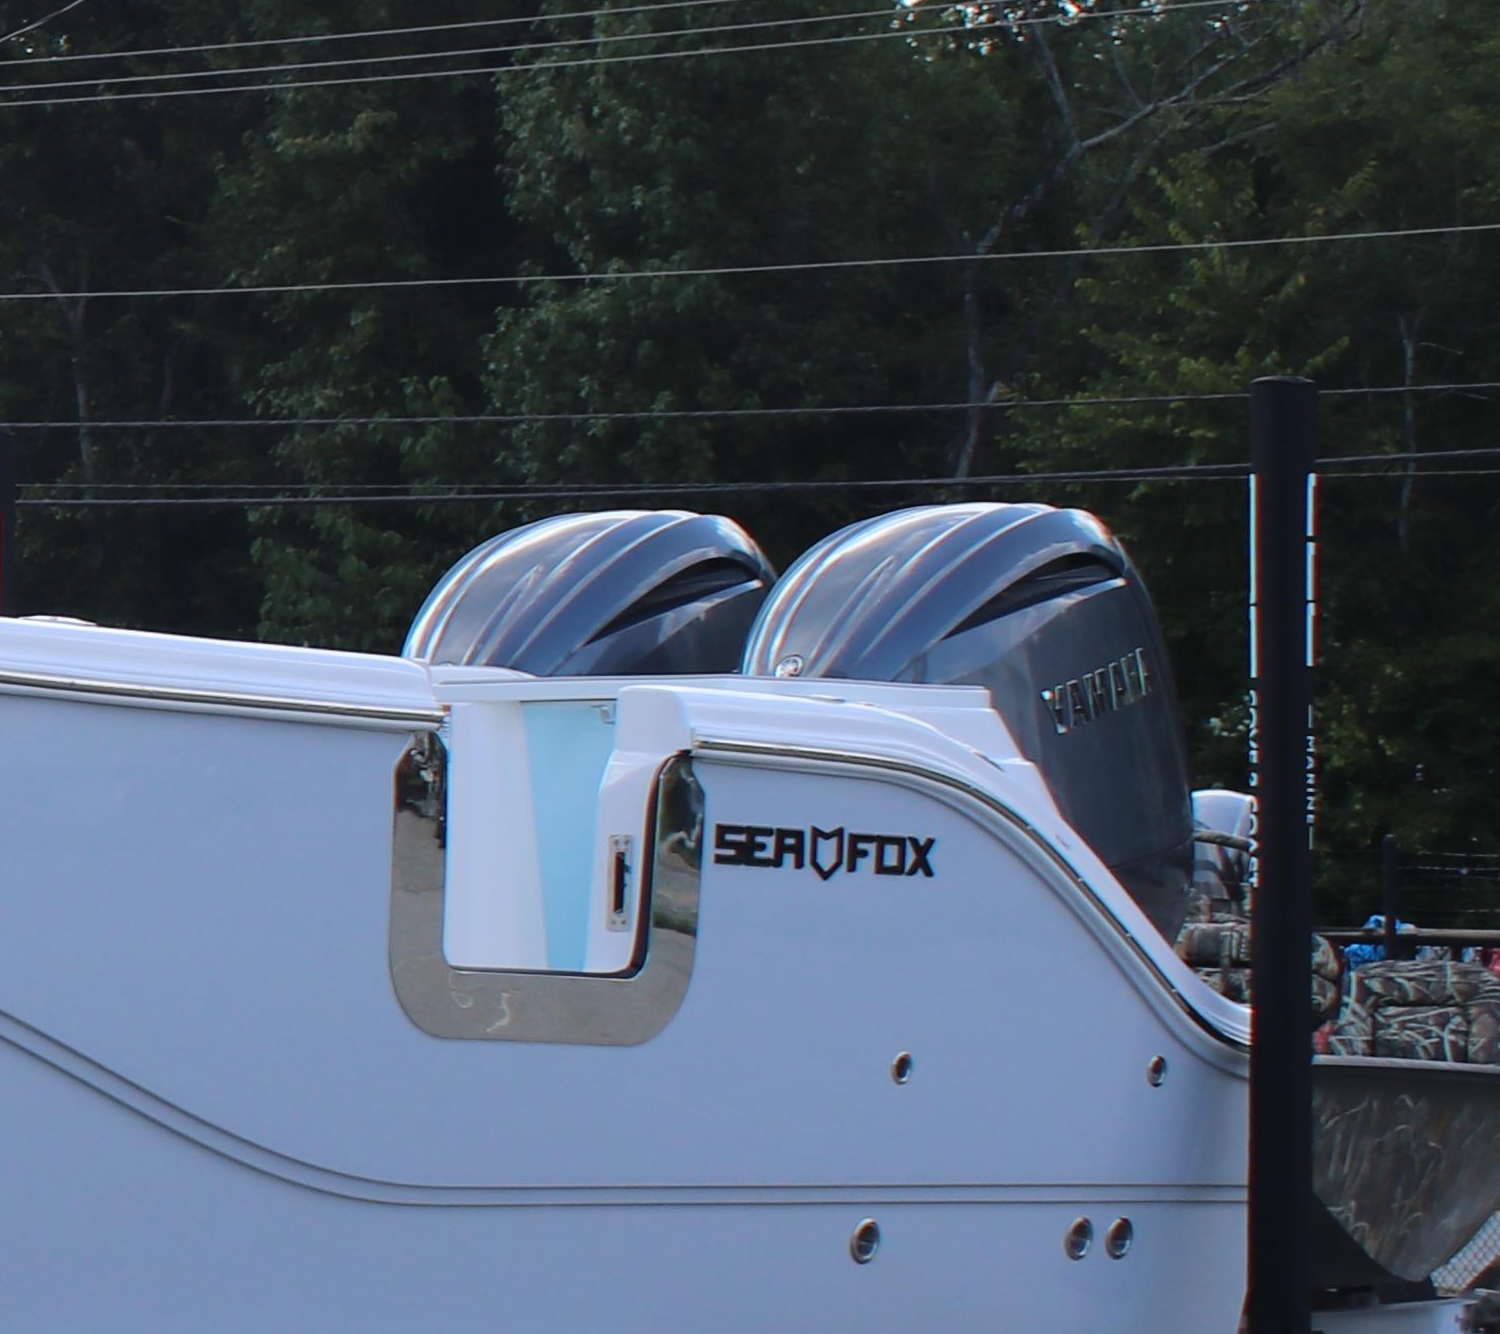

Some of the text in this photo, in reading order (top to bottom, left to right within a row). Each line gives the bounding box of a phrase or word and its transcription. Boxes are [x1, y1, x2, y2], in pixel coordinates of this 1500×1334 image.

[1040, 647, 1152, 735] YAMAHA
[713, 822, 936, 878] SEA FOX
